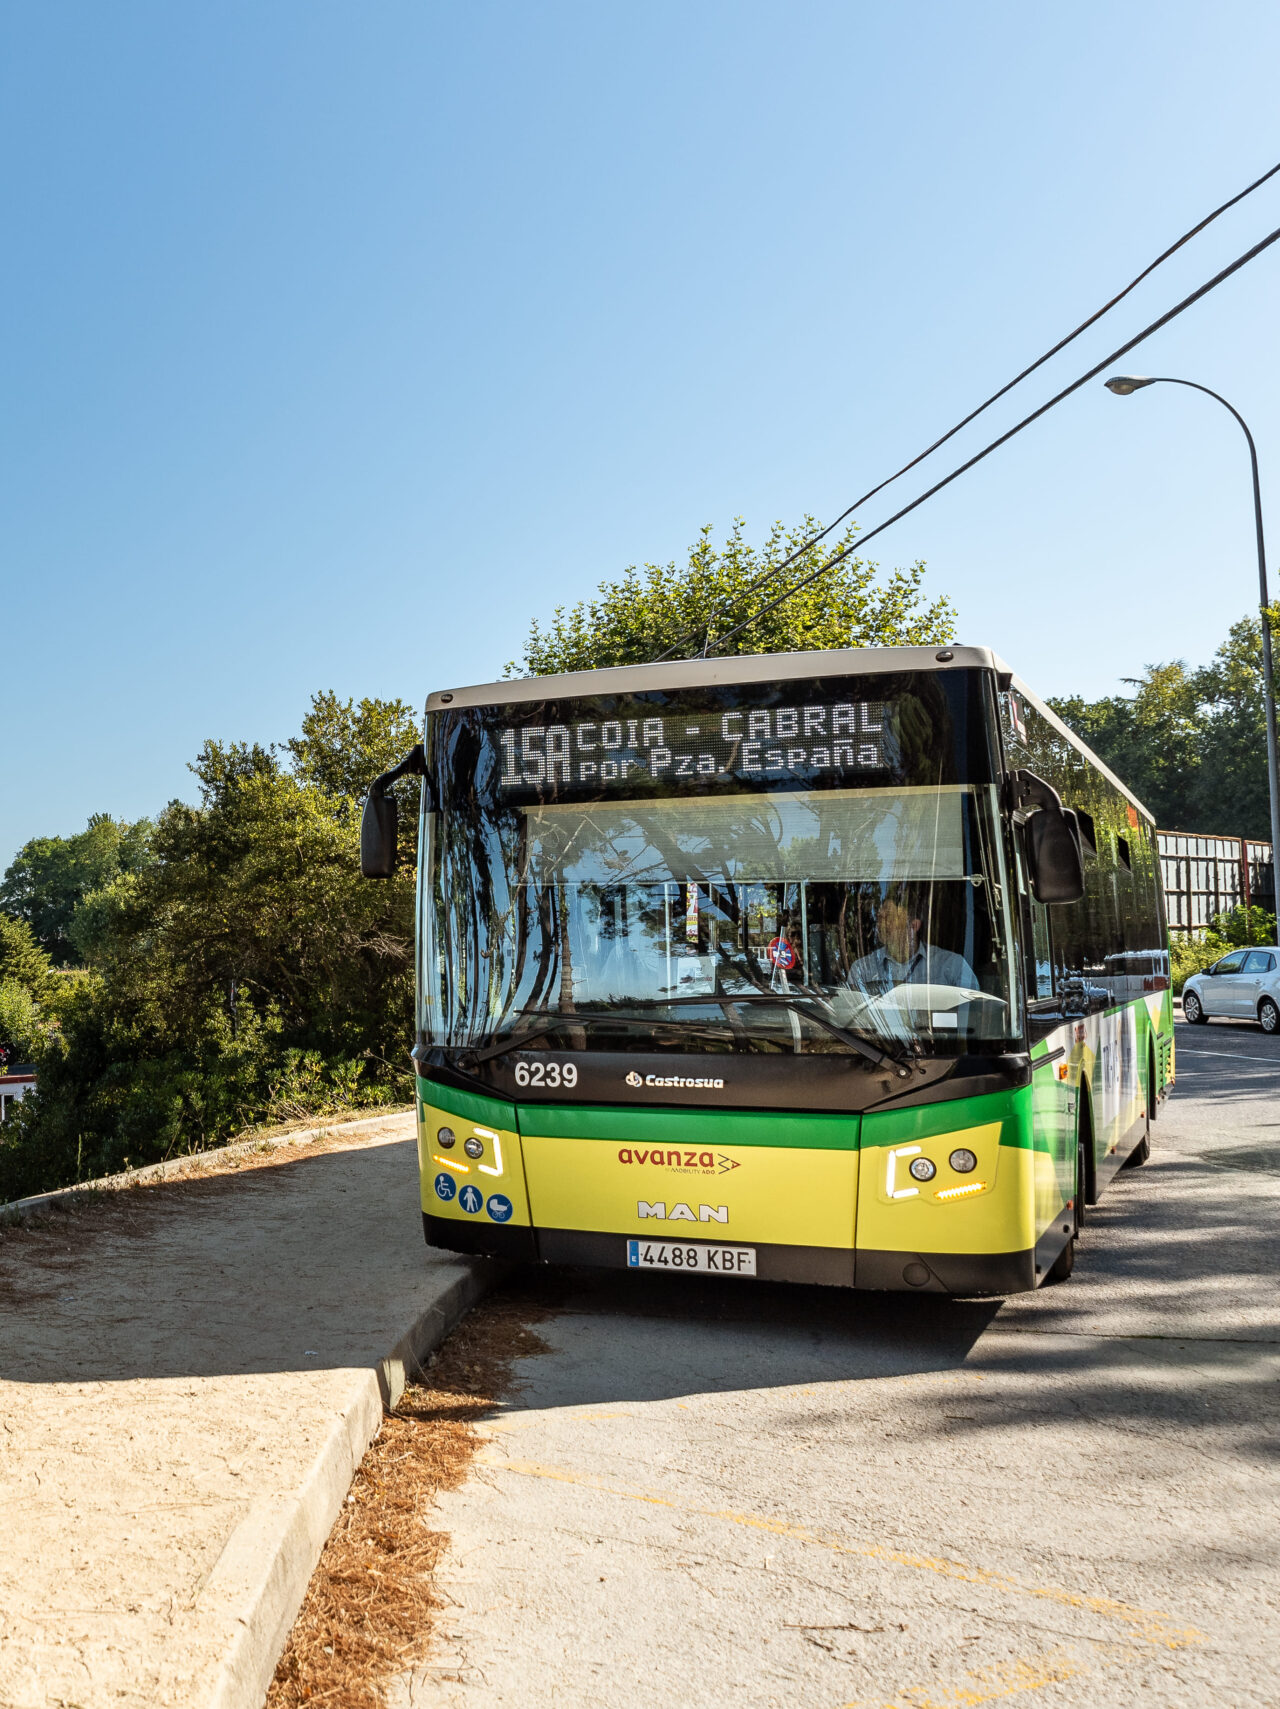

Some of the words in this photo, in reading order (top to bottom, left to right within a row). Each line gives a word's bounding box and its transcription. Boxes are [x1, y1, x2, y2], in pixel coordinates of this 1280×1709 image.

[577, 717, 664, 751] COIA
[721, 702, 882, 741] CABRAL
[500, 725, 570, 785] 15A
[579, 759, 635, 781] por
[650, 748, 725, 777] Pza.
[742, 739, 878, 771] España
[514, 1061, 578, 1088] 6239
[645, 1074, 724, 1089] Castrosua
[618, 1148, 715, 1168] avanza
[637, 1200, 729, 1224] MAN
[642, 1244, 699, 1268] 4488
[706, 1248, 750, 1272] KBF
